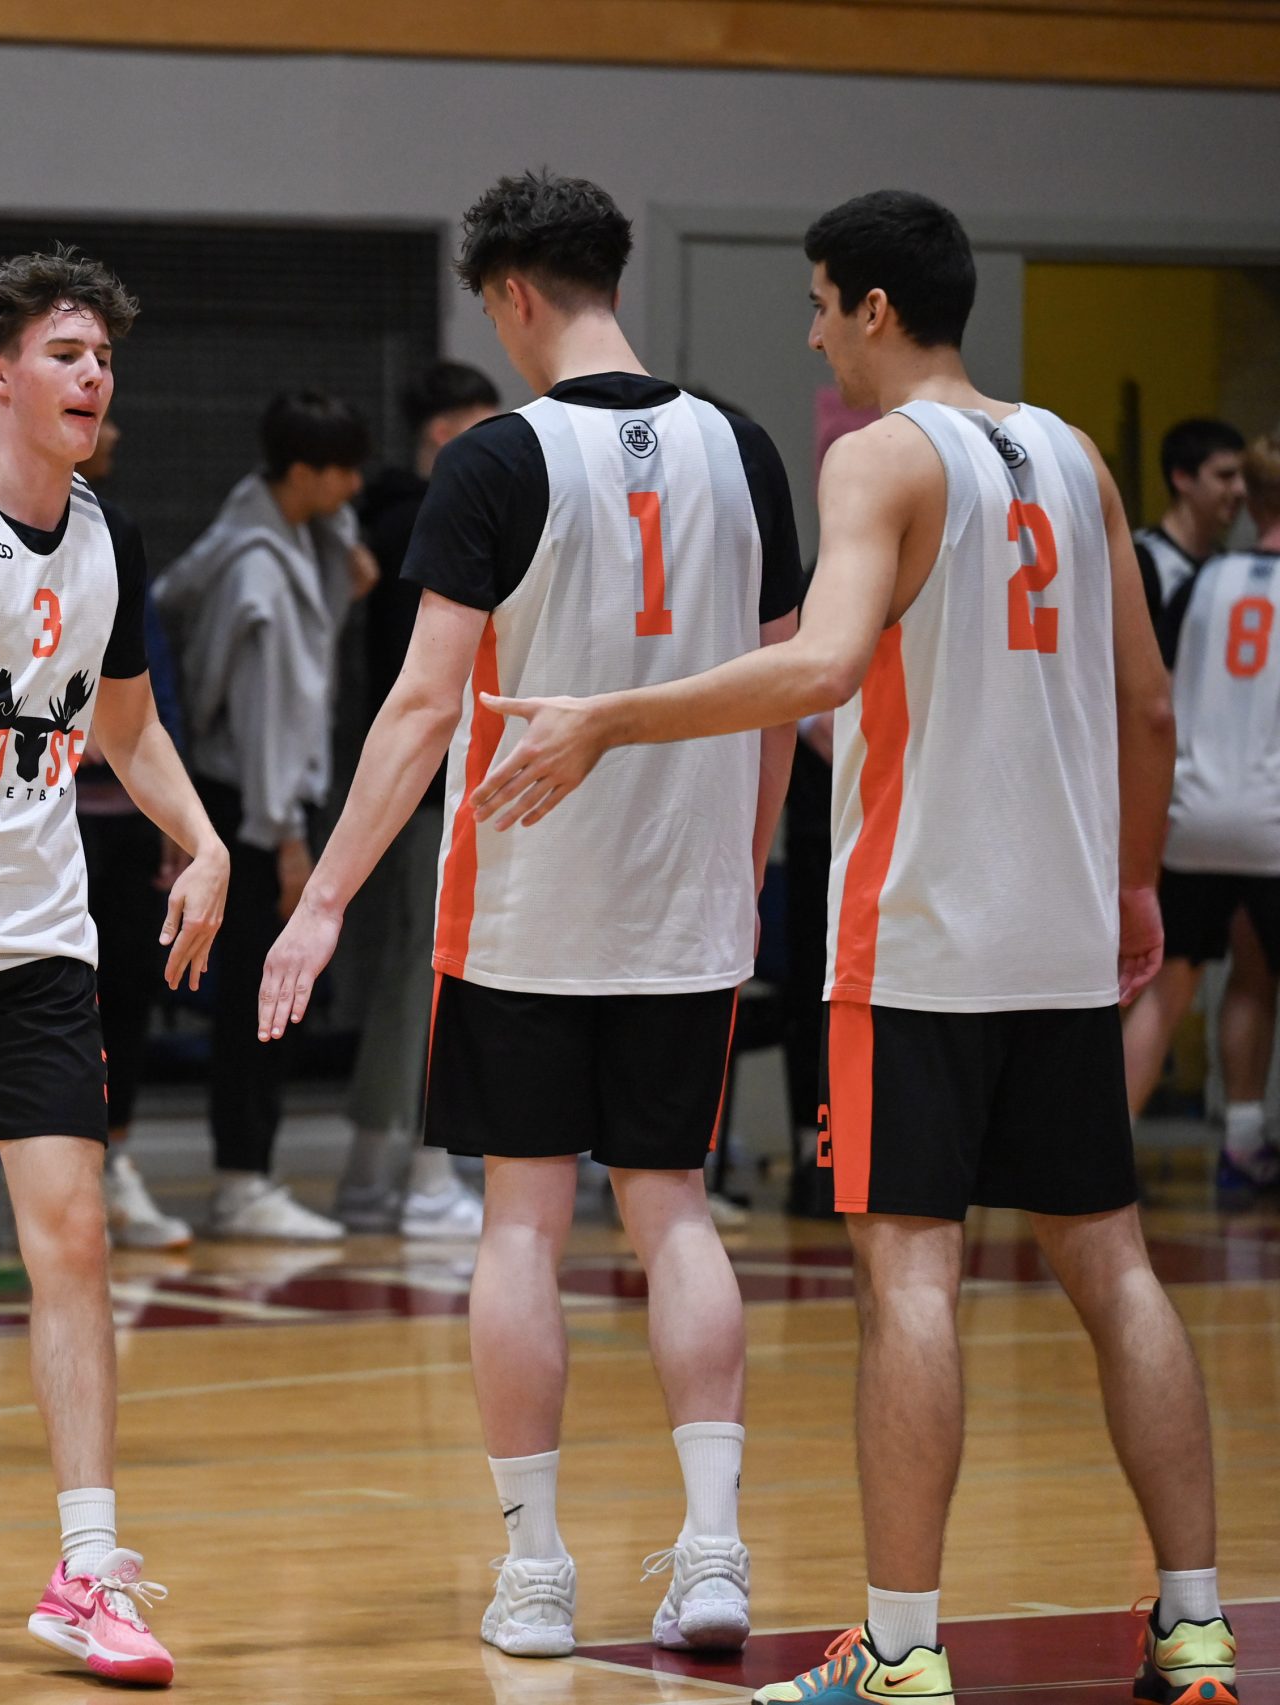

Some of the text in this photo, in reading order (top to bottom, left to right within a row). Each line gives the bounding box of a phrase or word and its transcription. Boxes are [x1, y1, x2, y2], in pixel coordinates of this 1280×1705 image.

[627, 491, 673, 637] 1
[1006, 498, 1058, 654] 2
[32, 588, 63, 659] 3
[1226, 596, 1275, 679] 8
